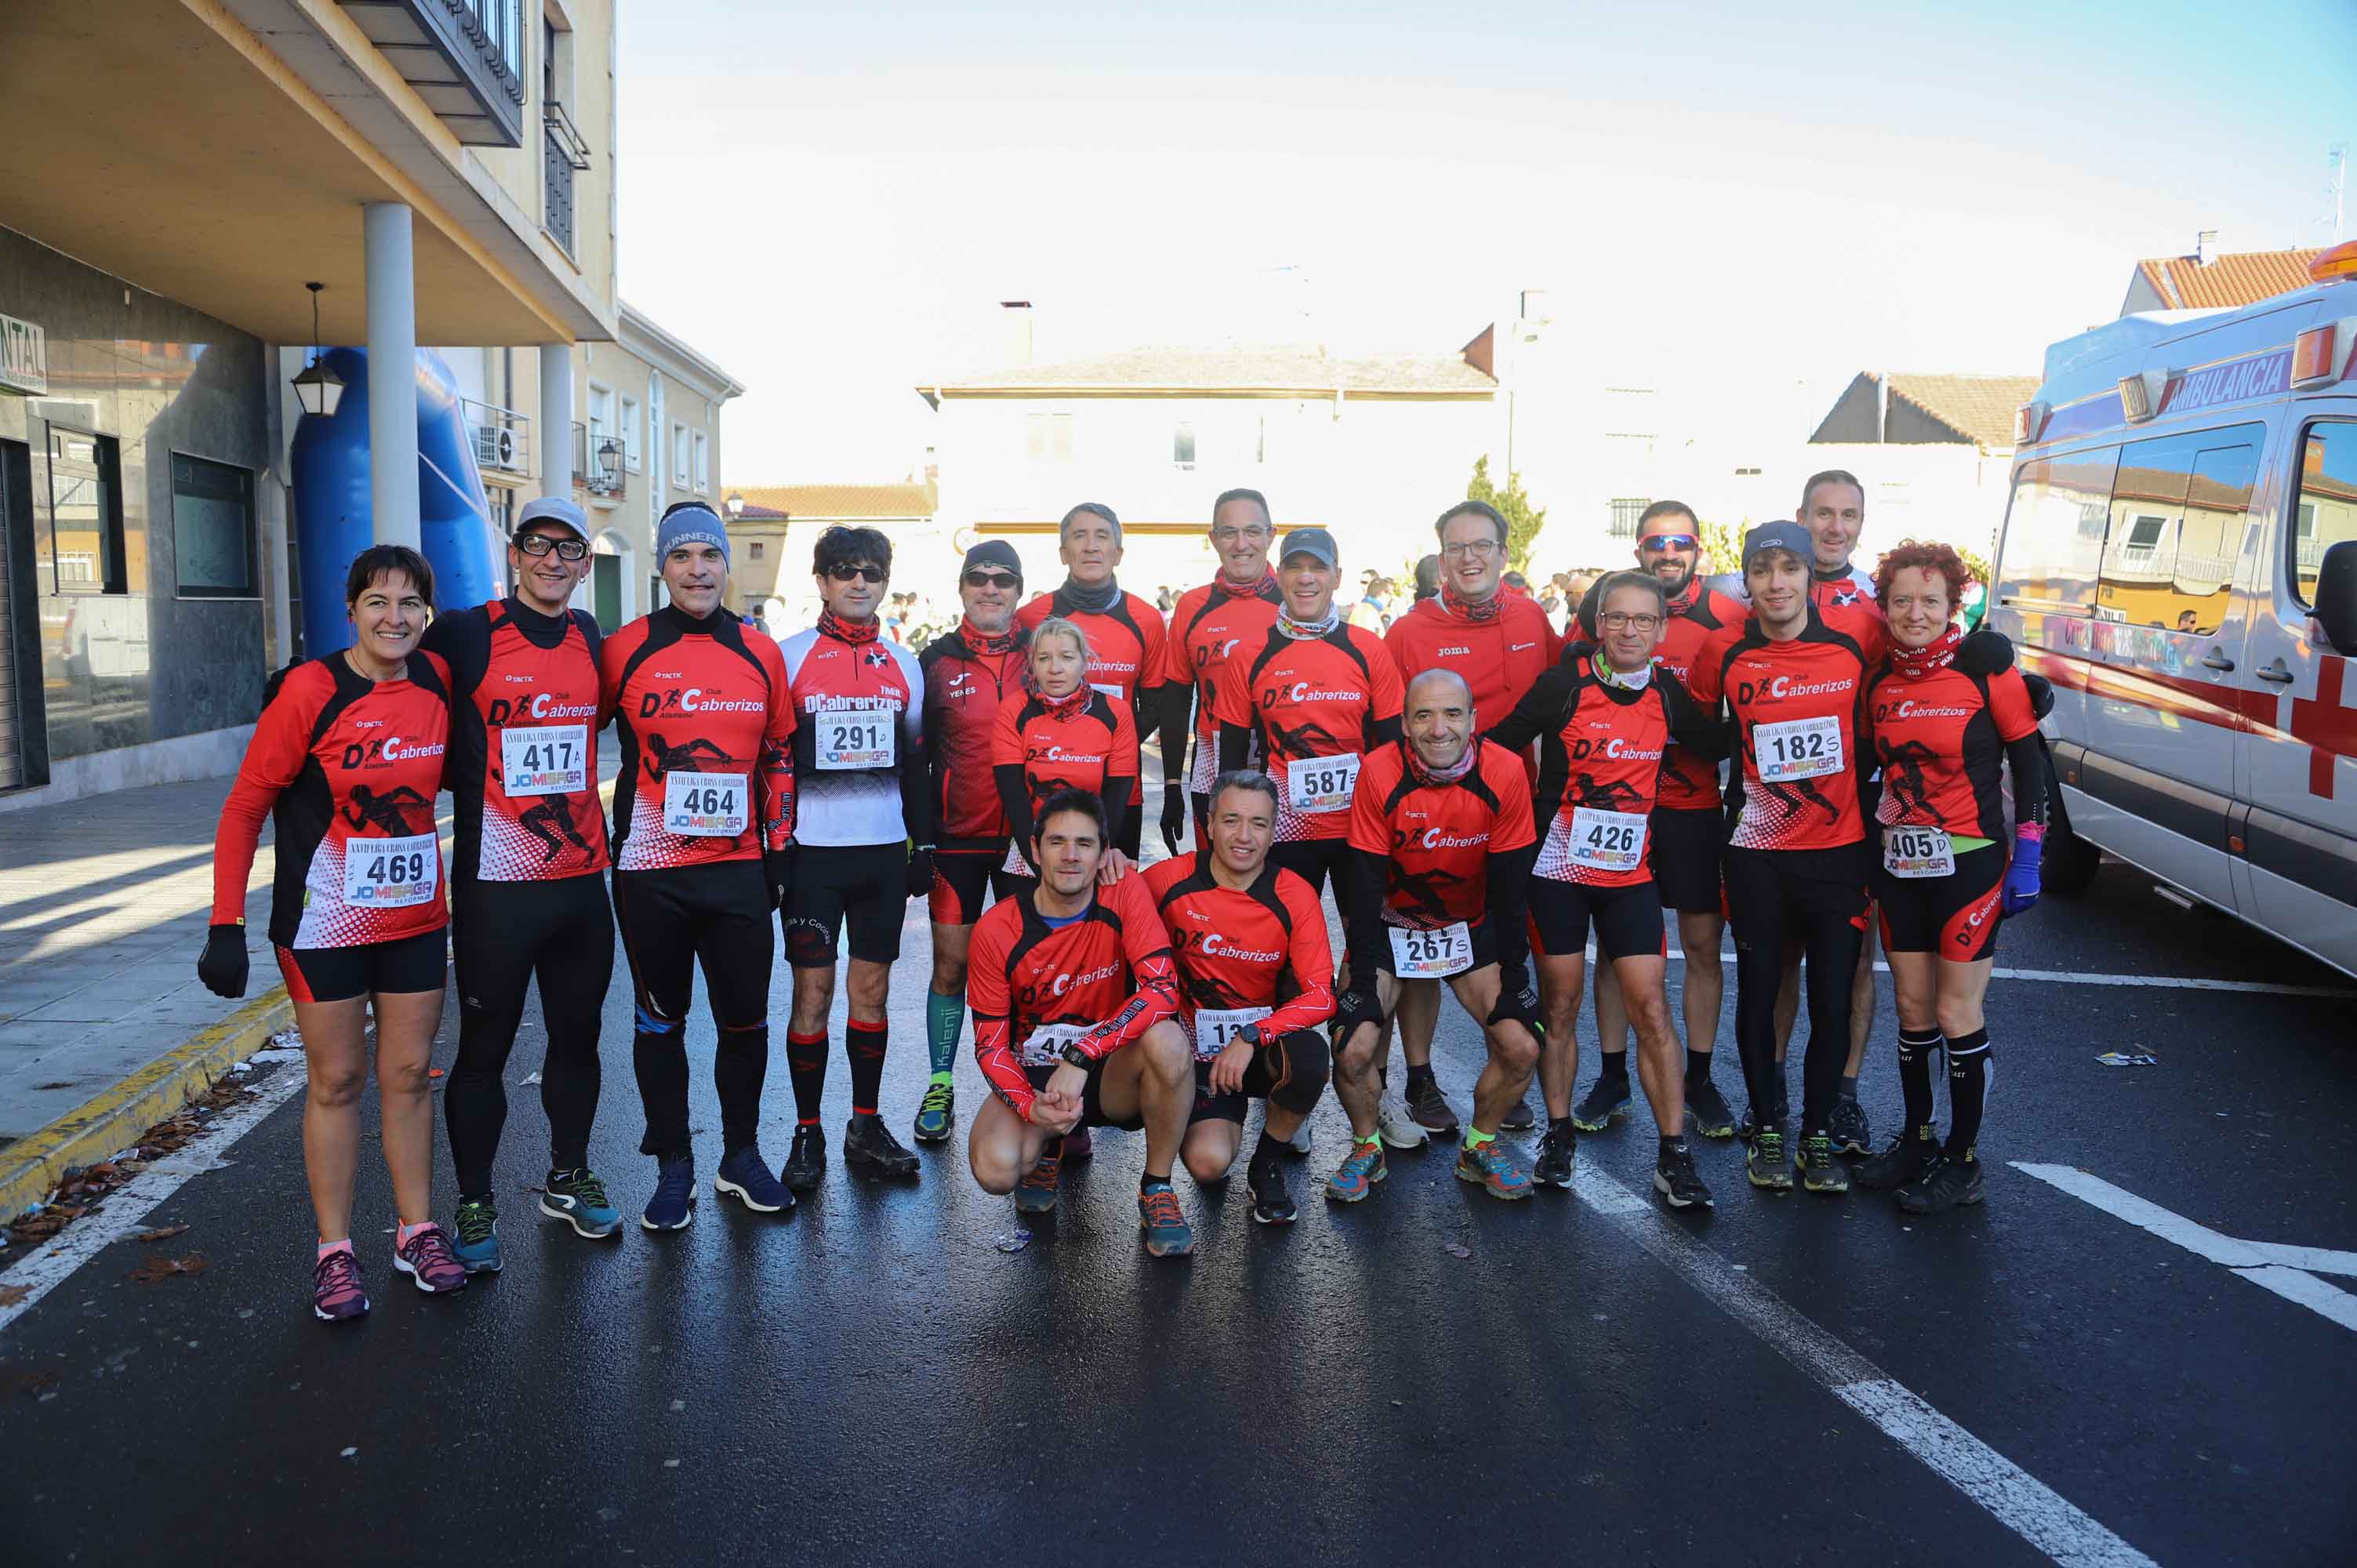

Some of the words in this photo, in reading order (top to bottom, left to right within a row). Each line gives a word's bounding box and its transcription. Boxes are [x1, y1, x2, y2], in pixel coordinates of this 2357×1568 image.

[2166, 354, 2286, 412] AMBULANCIA
[383, 737, 445, 760] Cabrerizo
[833, 726, 877, 750] 291
[1607, 739, 1662, 760] Cabrerizo
[1772, 733, 1825, 762] 182
[523, 742, 572, 771] 417
[1305, 769, 1347, 795] 587
[683, 789, 734, 815] 464
[1296, 793, 1351, 808] JOMISAG
[1587, 825, 1634, 851] 426
[1892, 833, 1933, 858] 405
[367, 853, 423, 884] 469
[1407, 938, 1453, 961] 267
